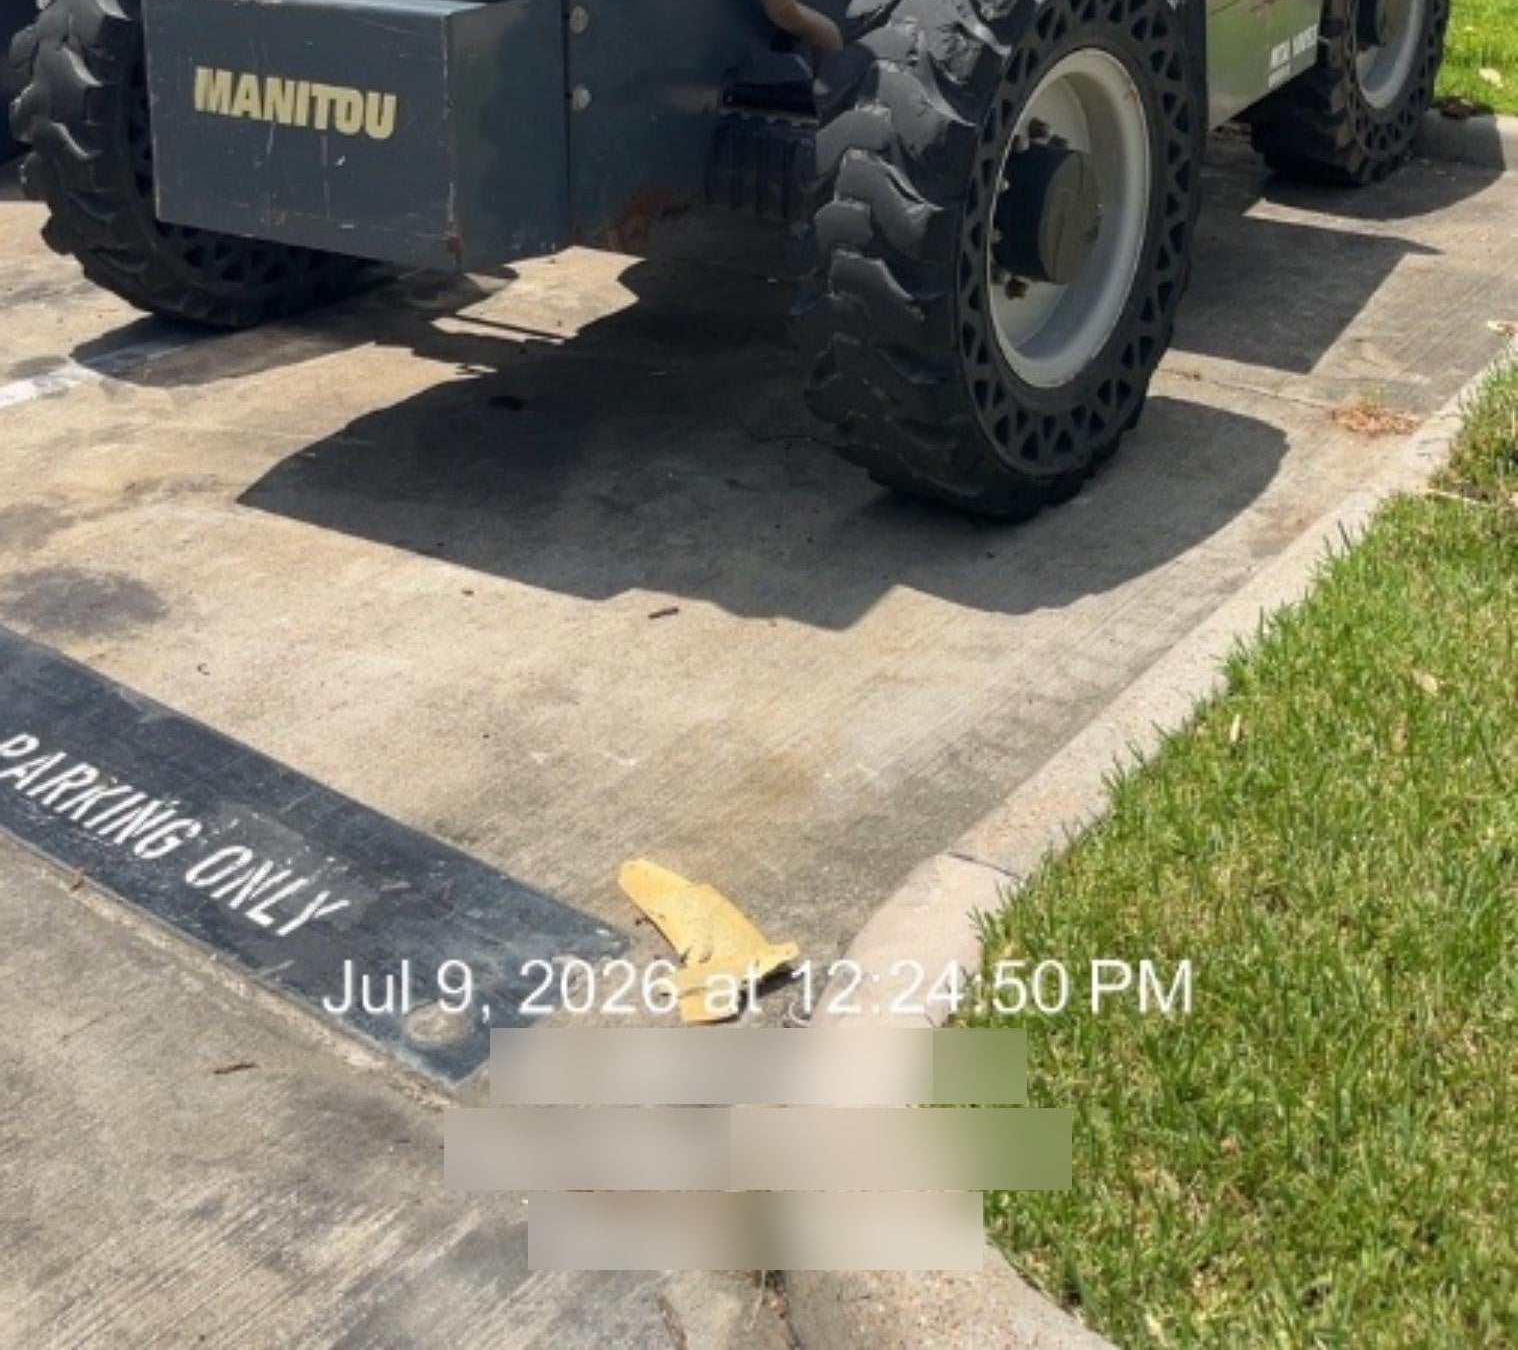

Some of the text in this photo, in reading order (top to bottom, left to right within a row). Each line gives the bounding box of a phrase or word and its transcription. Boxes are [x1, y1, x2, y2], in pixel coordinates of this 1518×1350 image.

[194, 66, 397, 139] MANITOU
[0, 732, 350, 936] PARKING ONLY
